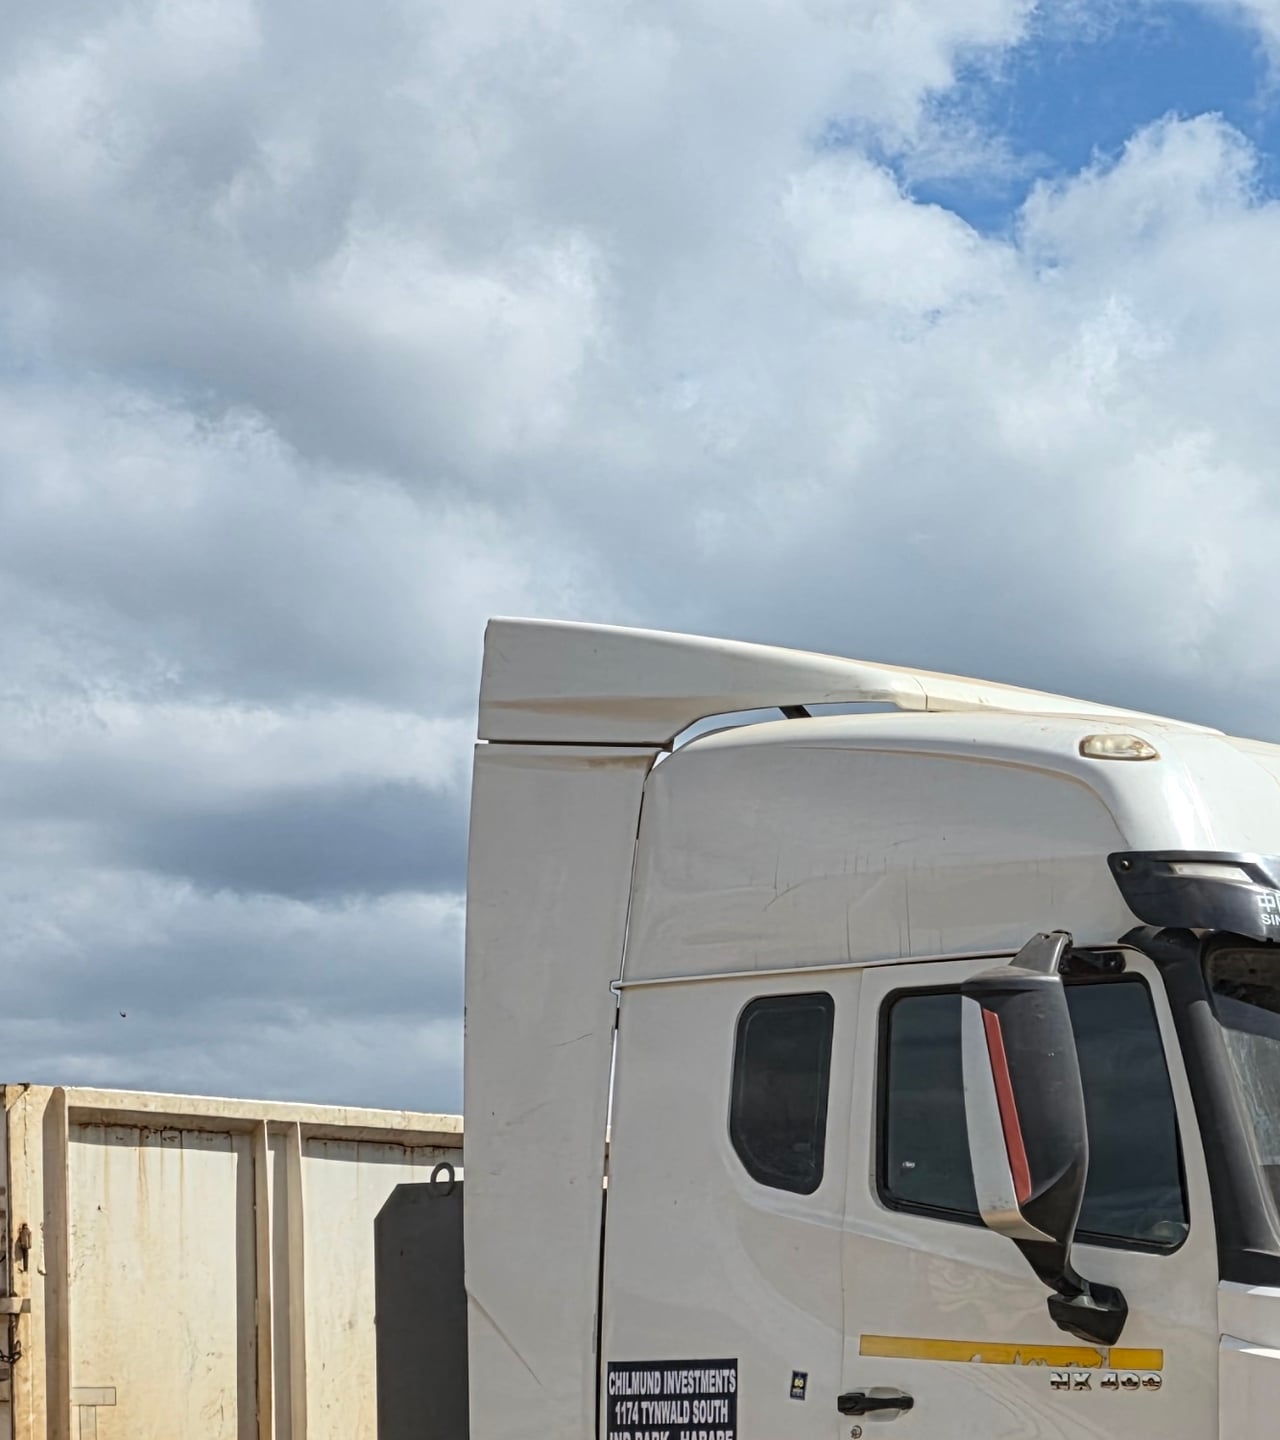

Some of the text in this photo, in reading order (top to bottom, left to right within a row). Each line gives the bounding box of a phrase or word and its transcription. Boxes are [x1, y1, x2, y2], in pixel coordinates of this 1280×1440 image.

[608, 1369, 737, 1396] CHILMUND INVESTMENTS
[1049, 1371, 1163, 1391] NX 400
[615, 1399, 729, 1425] 1174 TYNWALD SOUTH
